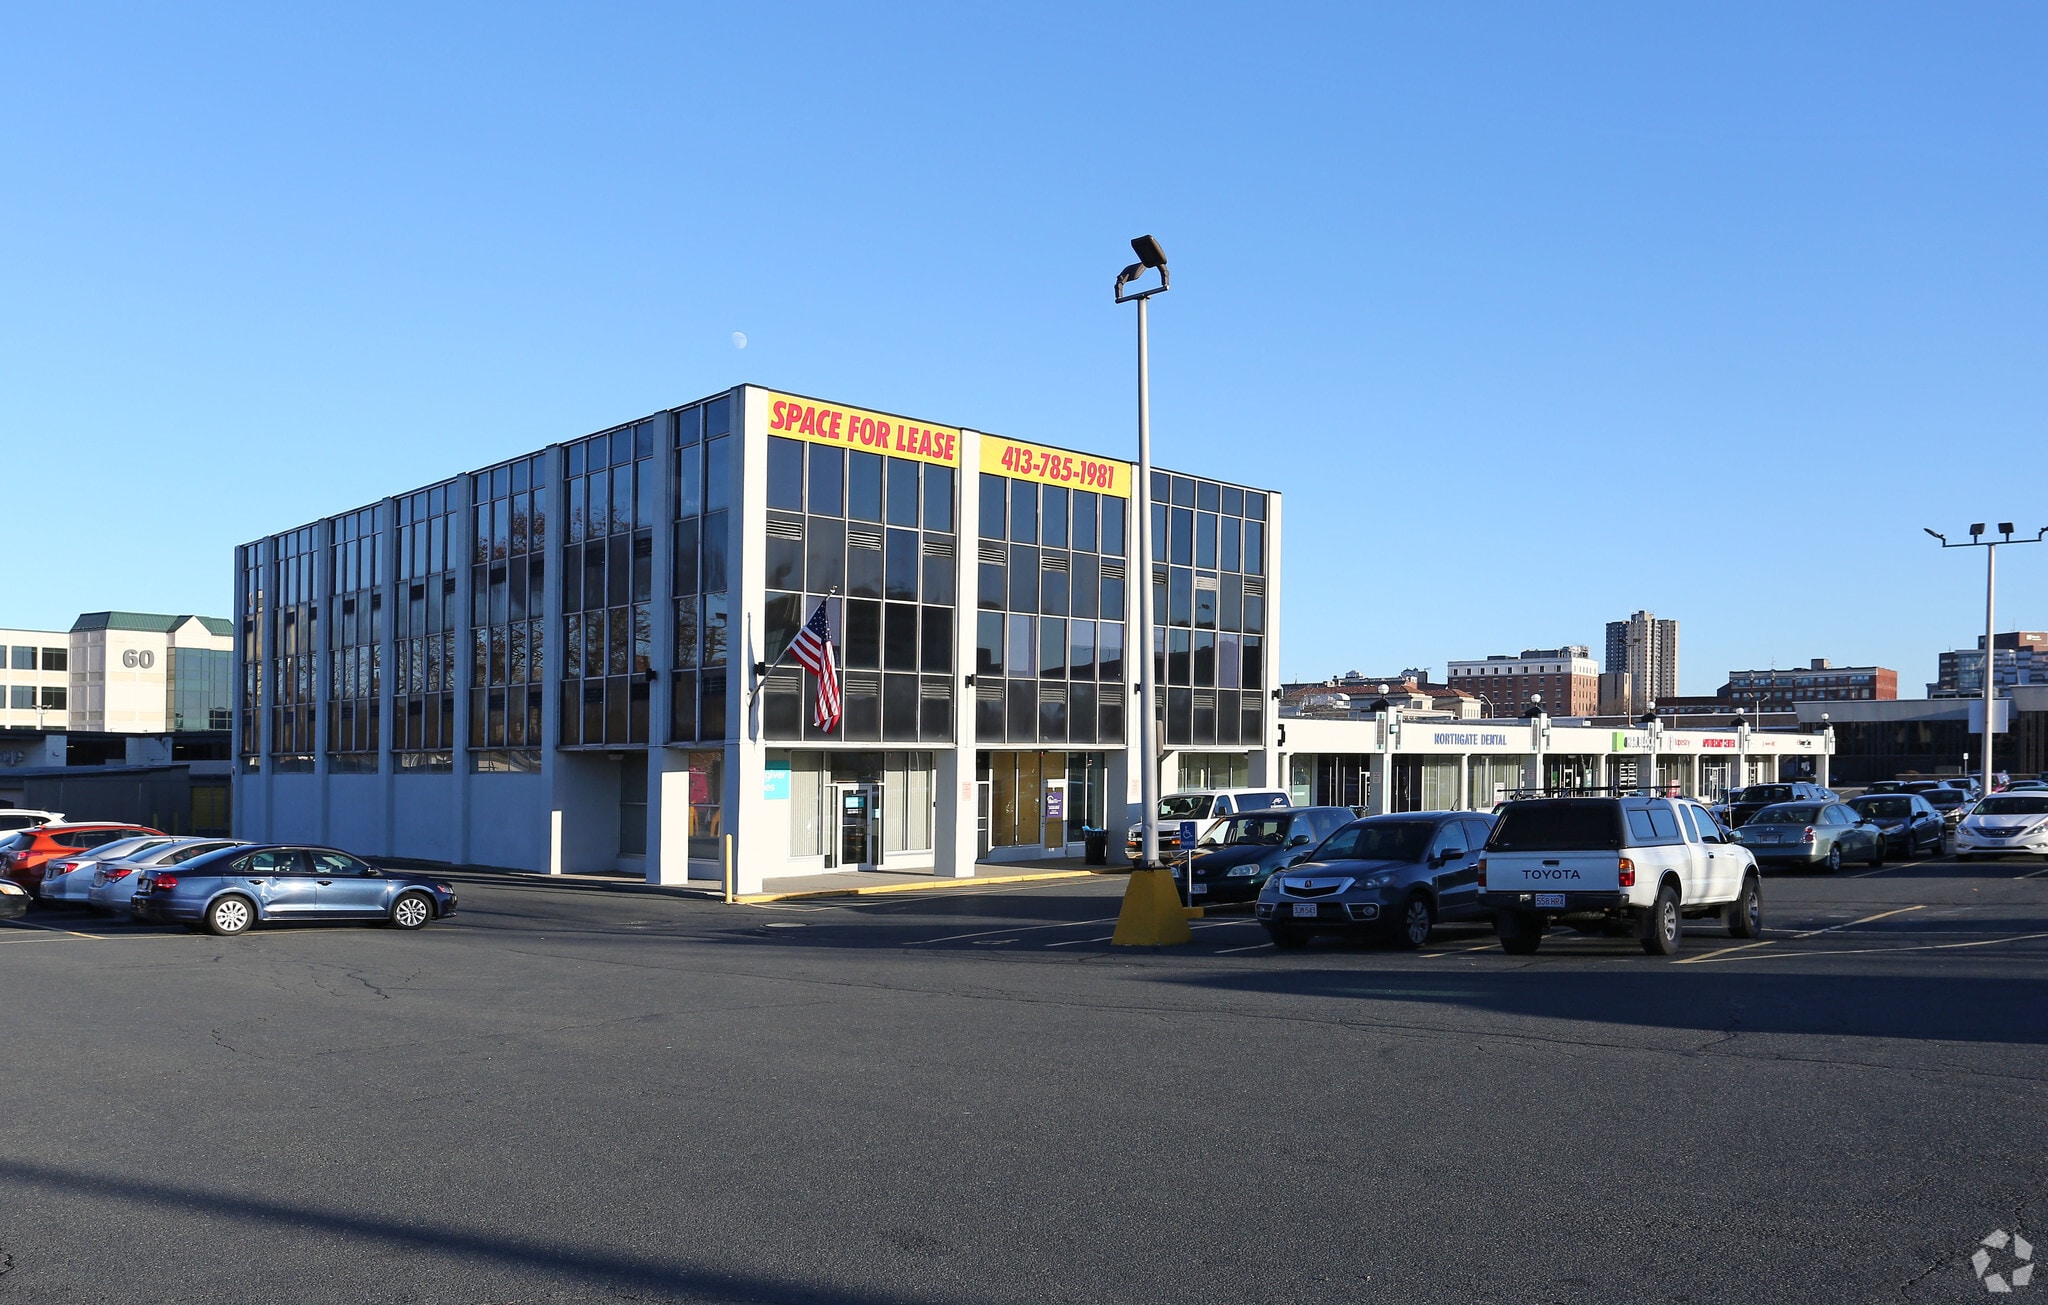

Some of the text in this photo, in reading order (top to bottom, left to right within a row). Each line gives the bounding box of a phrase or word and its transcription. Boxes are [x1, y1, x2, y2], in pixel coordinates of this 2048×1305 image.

[770, 401, 956, 460] SPACE FOR LEASE
[1001, 446, 1114, 489] 413-785-1981
[122, 649, 155, 669] 60
[1434, 733, 1507, 745] NORTHGATE DENTAL
[1522, 869, 1581, 880] TOYOTA
[1536, 897, 1550, 905] 558
